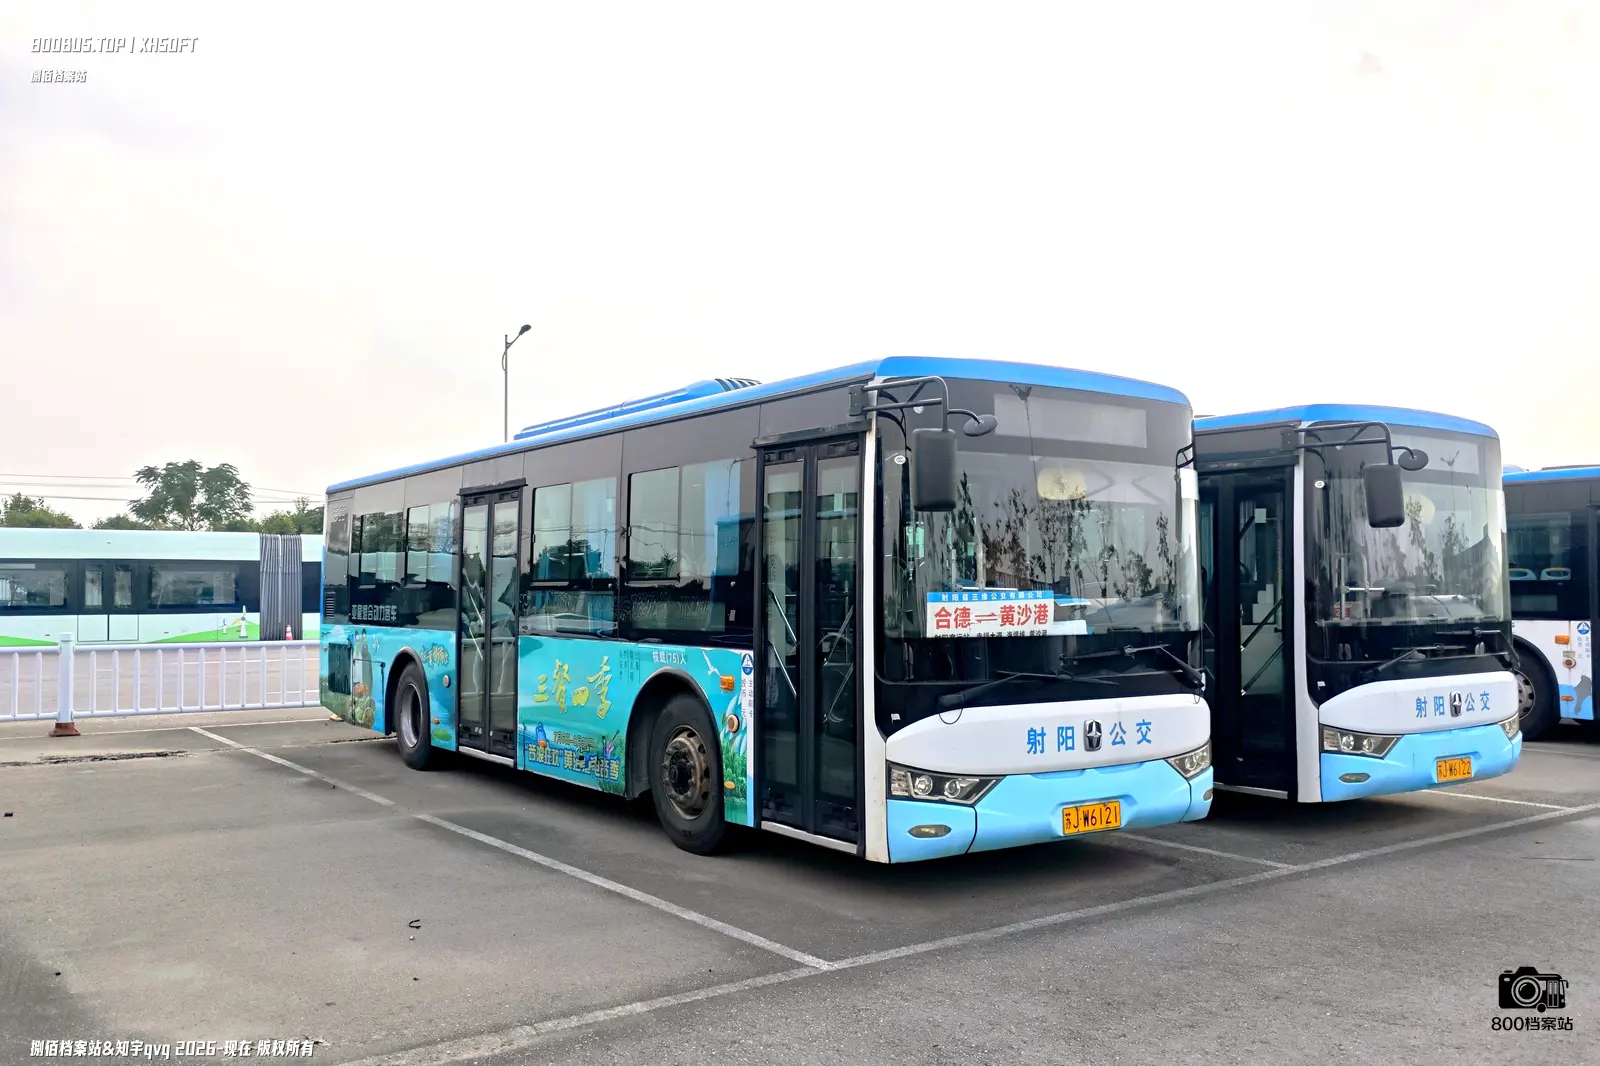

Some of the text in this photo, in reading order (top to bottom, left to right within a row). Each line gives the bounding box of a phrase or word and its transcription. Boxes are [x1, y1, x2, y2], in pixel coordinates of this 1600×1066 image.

[934, 603, 1049, 630] 合德 黄沙港
[1415, 691, 1490, 719] 射阳公交
[1026, 719, 1152, 755] 射阳公交
